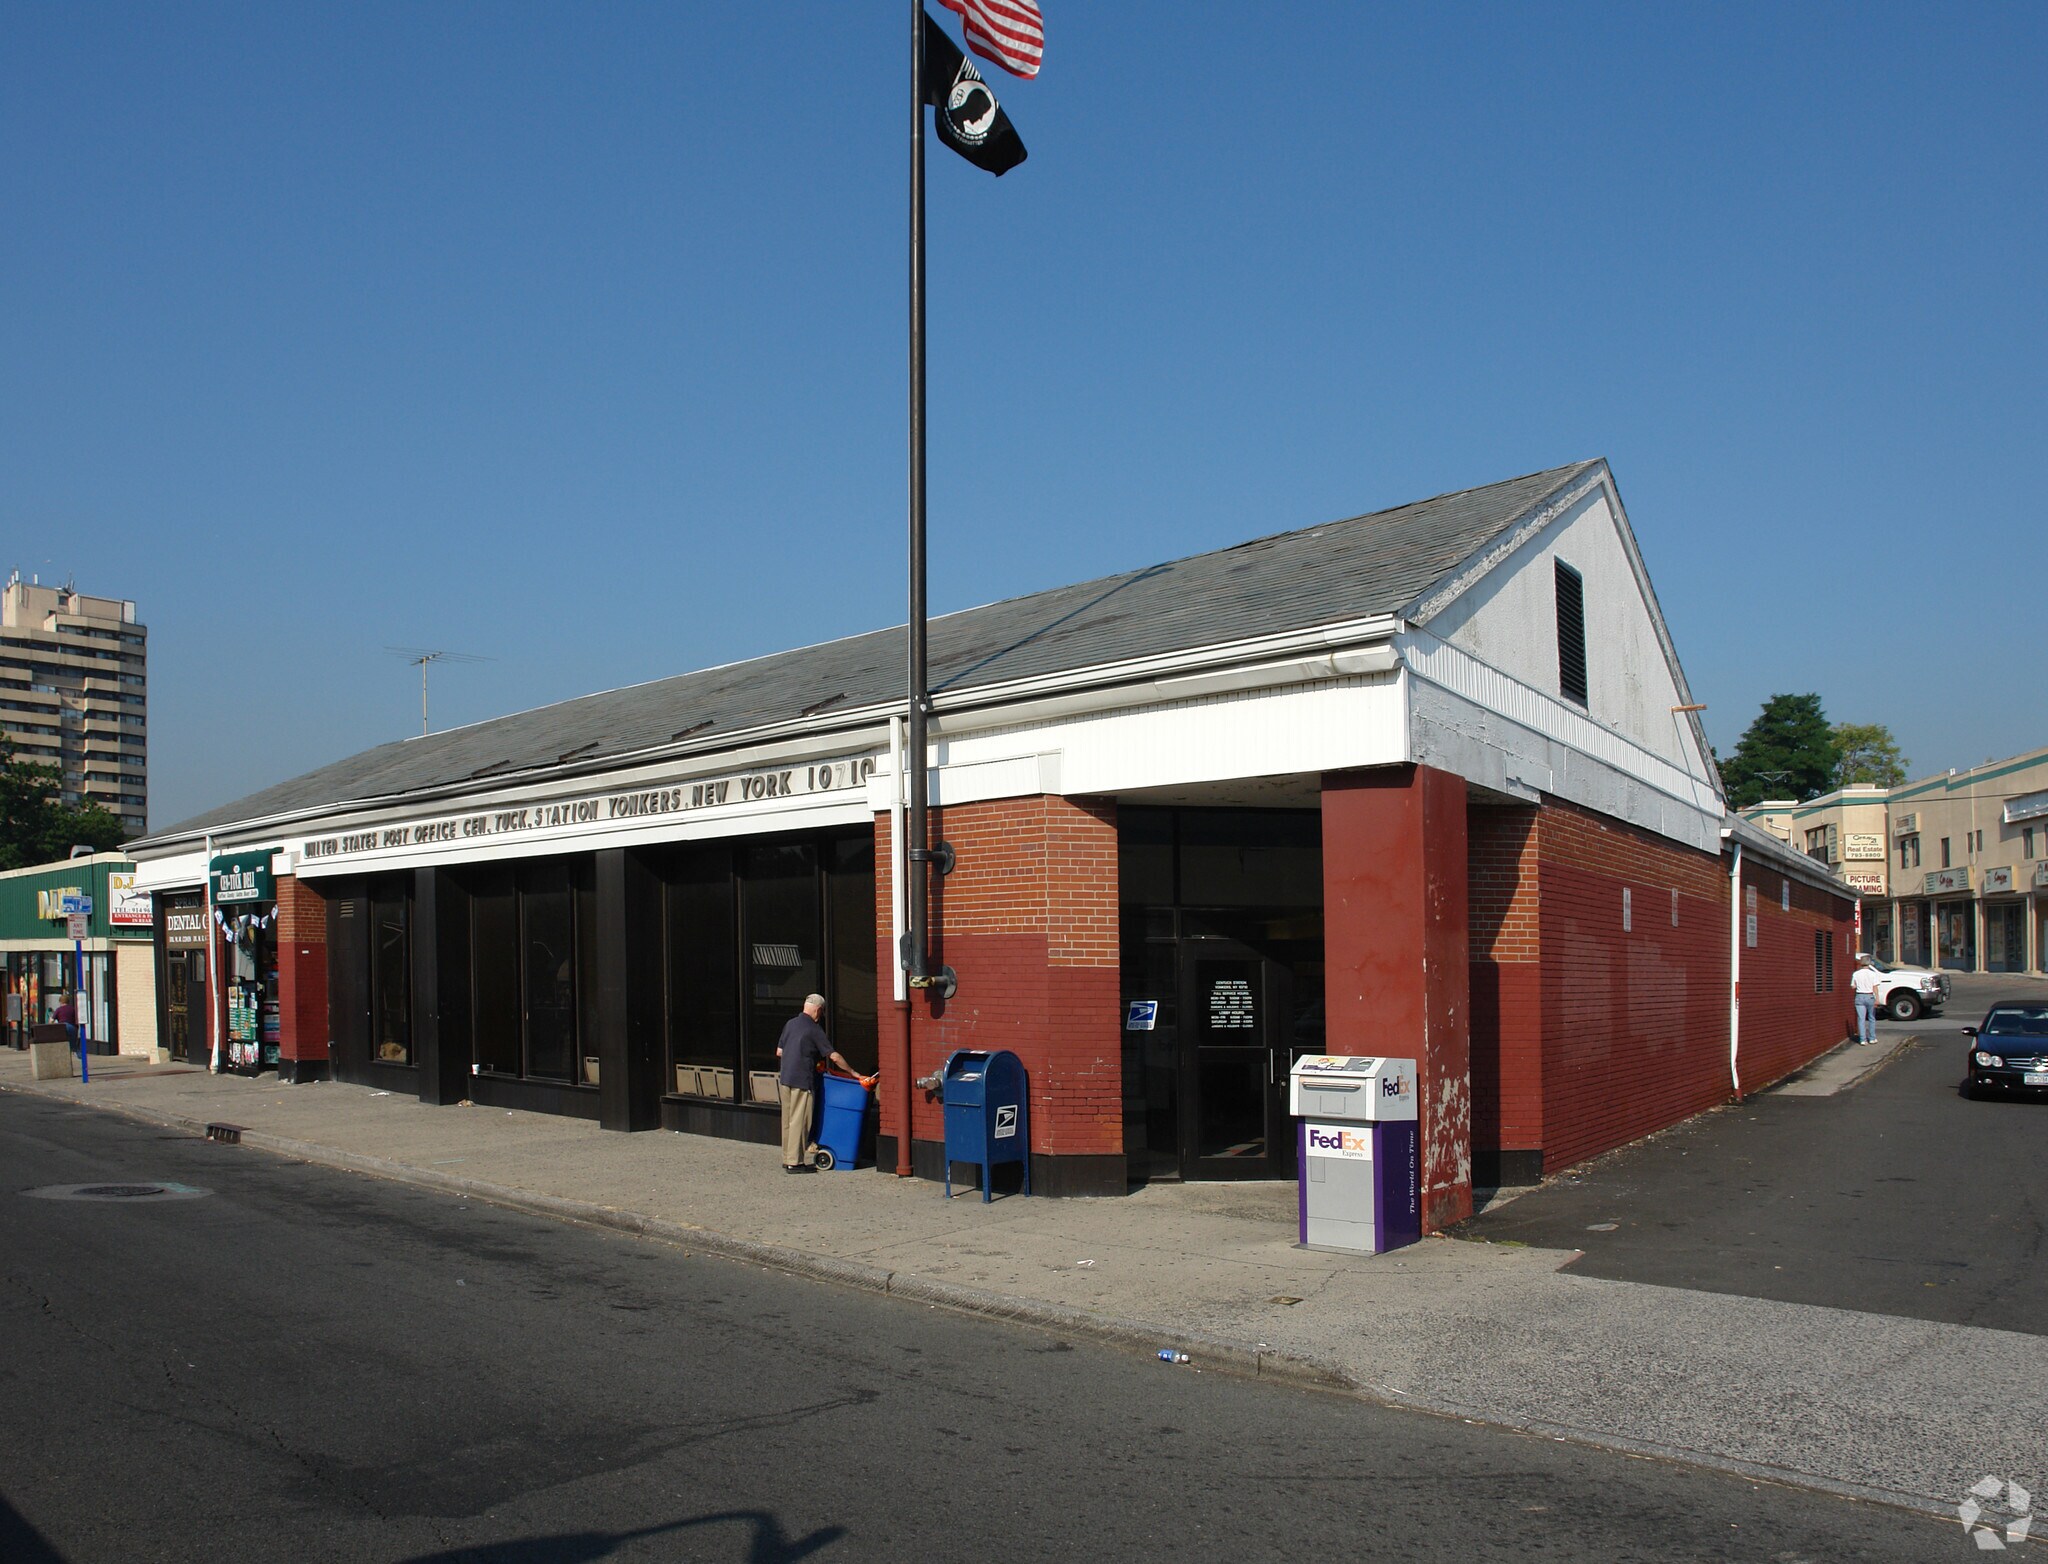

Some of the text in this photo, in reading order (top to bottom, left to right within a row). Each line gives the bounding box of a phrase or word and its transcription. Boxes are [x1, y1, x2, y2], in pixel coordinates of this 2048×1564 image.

[304, 838, 338, 858] UNITED
[342, 832, 377, 852] STATES
[383, 828, 409, 847] POST
[414, 821, 456, 842] OFFICE
[534, 800, 598, 827] STATION
[692, 780, 729, 807] NEW
[741, 771, 792, 800] YORK
[808, 758, 875, 790] 10710
[167, 914, 201, 931] DENTAL
[1382, 1075, 1410, 1098] FedEx
[1309, 1129, 1365, 1151] FedEx
[1342, 1150, 1363, 1158] Express
[1409, 1156, 1415, 1169] On
